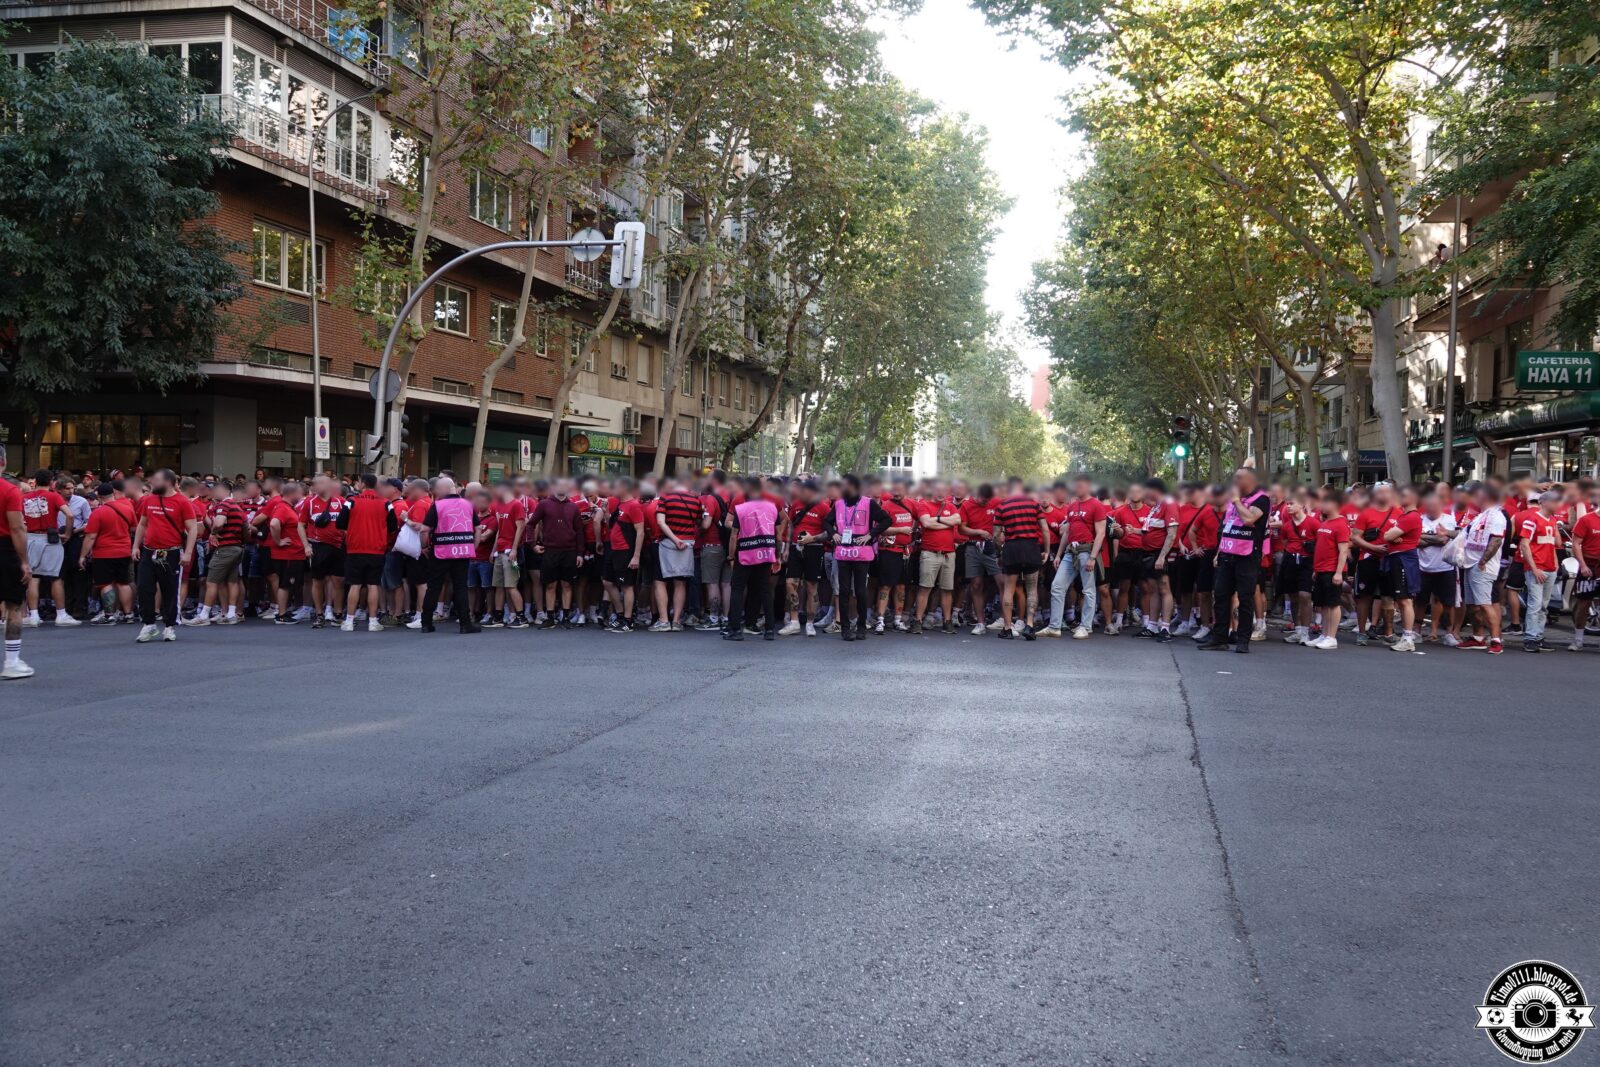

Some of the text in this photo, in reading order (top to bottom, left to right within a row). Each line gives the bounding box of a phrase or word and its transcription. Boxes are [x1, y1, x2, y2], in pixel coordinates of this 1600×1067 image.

[1528, 357, 1592, 365] CAFETERIA
[1527, 367, 1592, 383] HAYA 11
[258, 426, 283, 436] PANARIA
[452, 546, 470, 555] 011
[757, 550, 773, 560] 017
[840, 547, 859, 558] 010
